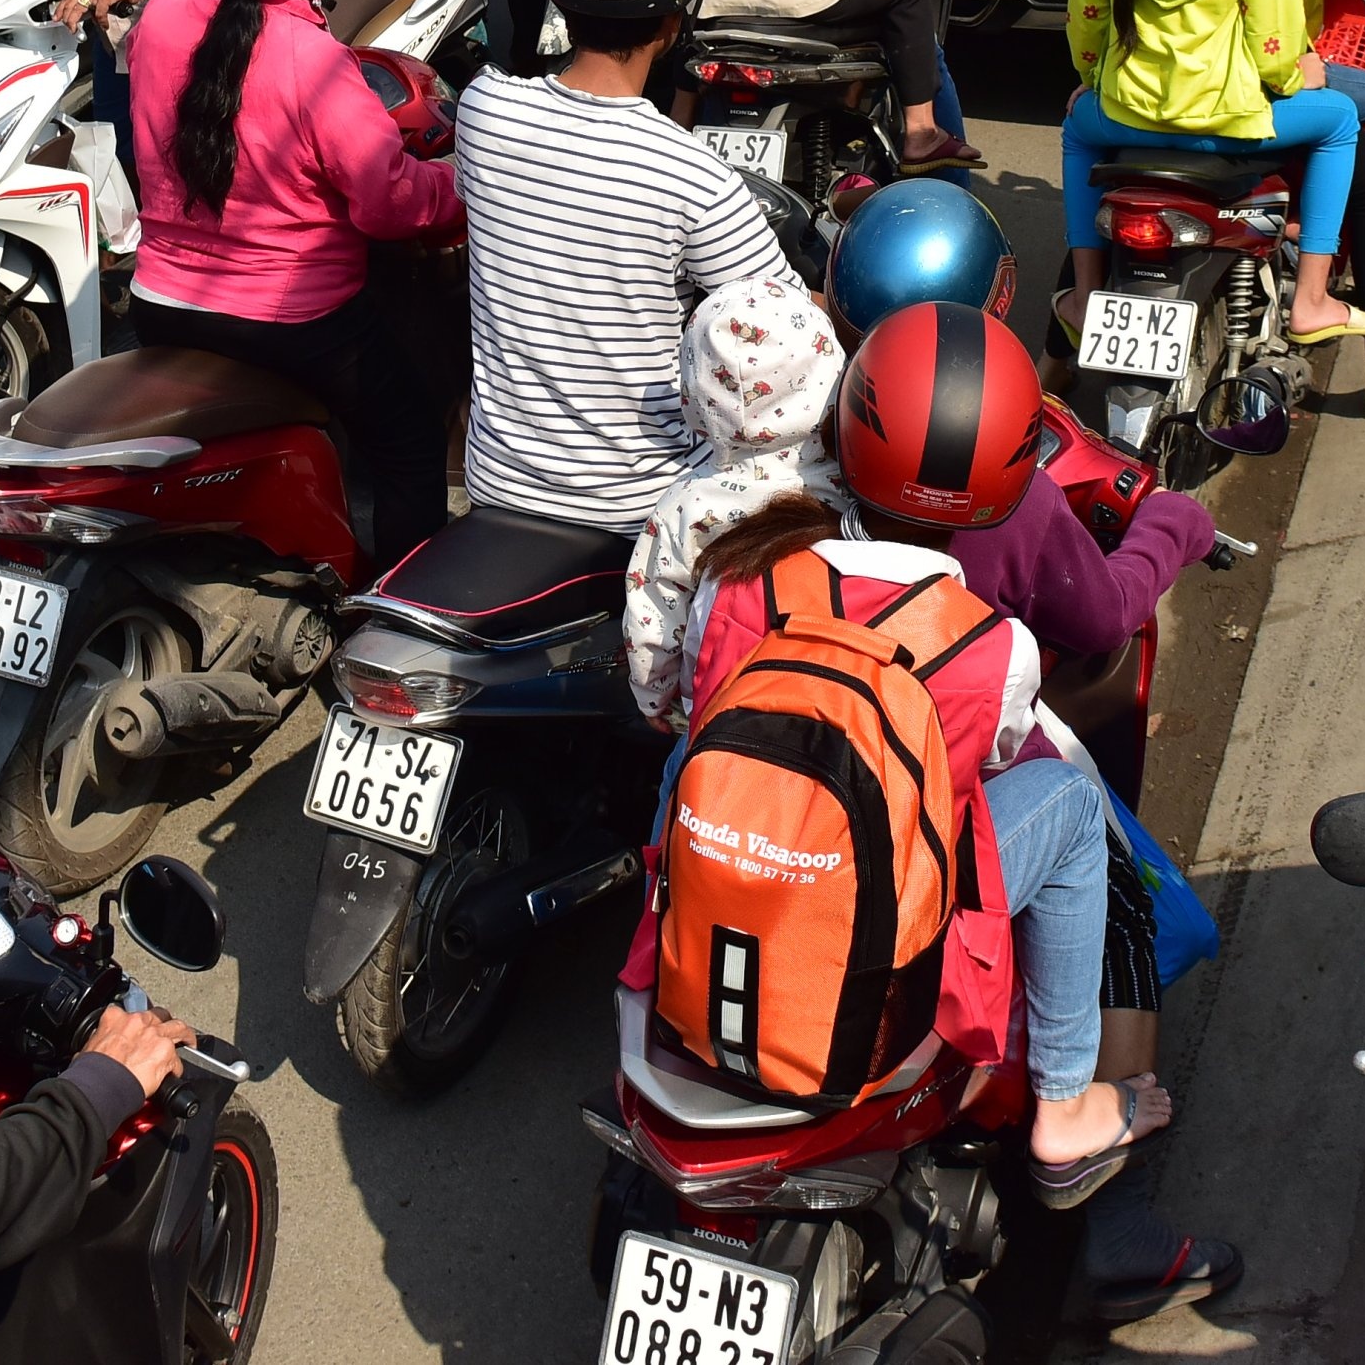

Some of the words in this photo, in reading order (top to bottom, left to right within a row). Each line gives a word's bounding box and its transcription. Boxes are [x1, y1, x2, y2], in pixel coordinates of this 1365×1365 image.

[729, 108, 759, 117] HONDA
[1218, 208, 1266, 222] BLADE
[1132, 269, 1168, 279] HONDA
[1102, 299, 1178, 337] 59-N2
[1086, 333, 1182, 373] 792.13
[923, 487, 954, 498] HONDA
[8, 561, 43, 577] HONDA
[328, 770, 424, 835] 0656
[678, 803, 740, 849] Honda
[746, 832, 842, 871] Visacoop
[343, 852, 387, 879] 045
[689, 839, 731, 865] Hotline:
[734, 856, 762, 875] 1800
[763, 866, 779, 880] 57
[780, 871, 797, 884] 77
[799, 873, 816, 884] 36
[692, 1227, 749, 1251] HONDA
[641, 1248, 769, 1336] 59-N3
